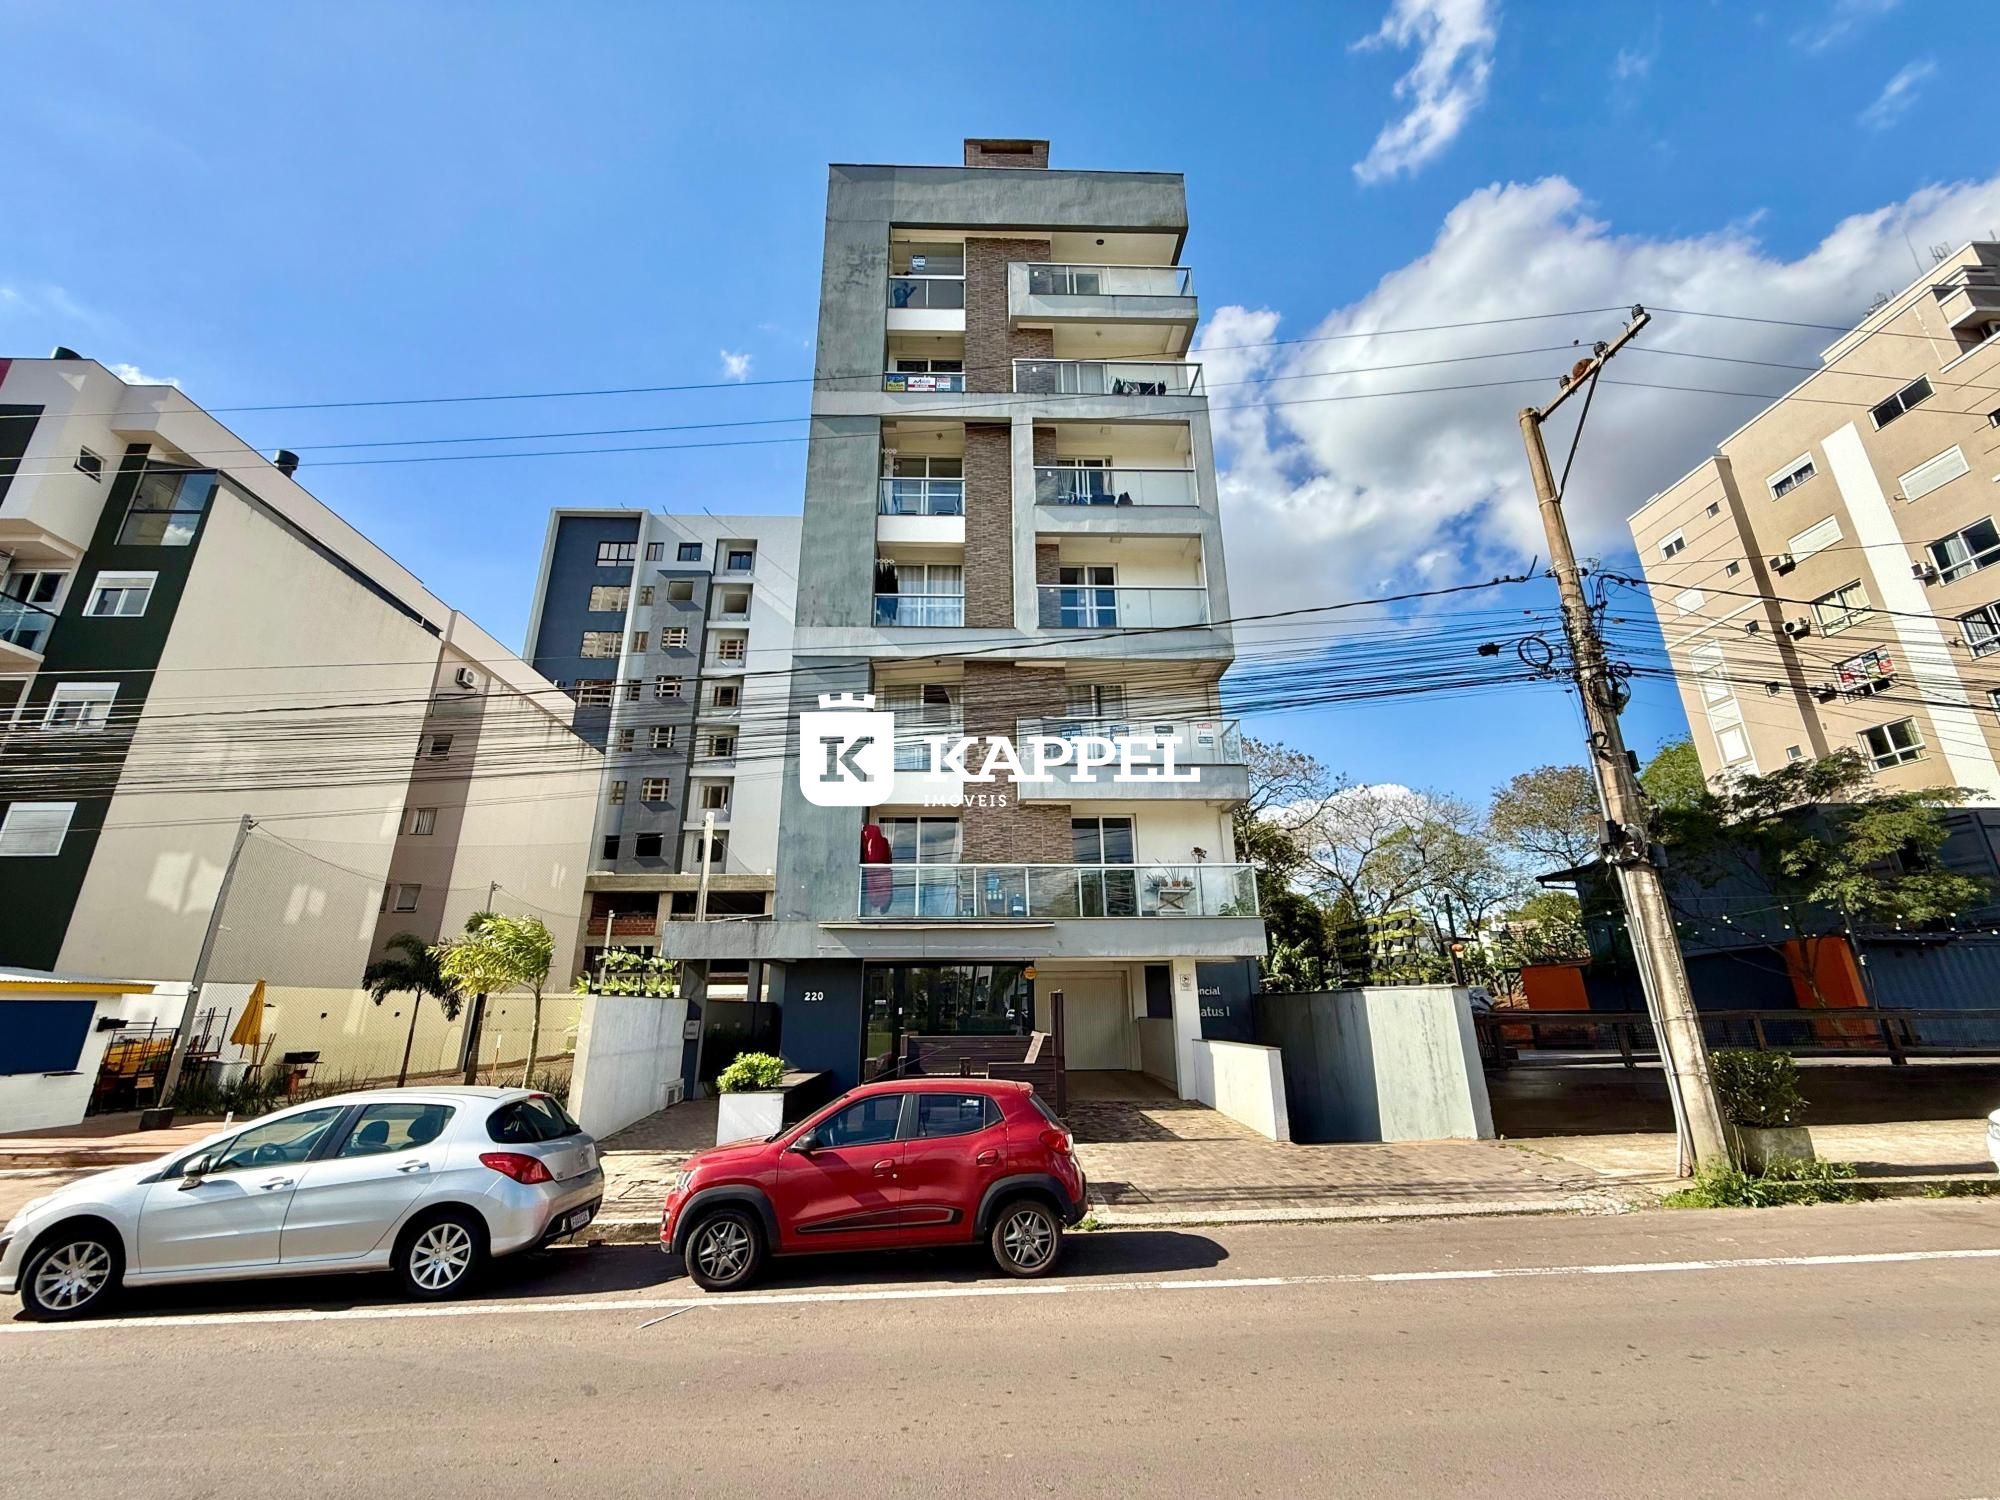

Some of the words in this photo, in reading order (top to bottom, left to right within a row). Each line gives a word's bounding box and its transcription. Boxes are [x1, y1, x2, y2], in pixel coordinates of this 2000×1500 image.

[804, 991, 824, 1001] 220
[1199, 986, 1221, 996] ncial
[1200, 1006, 1224, 1017] atus
